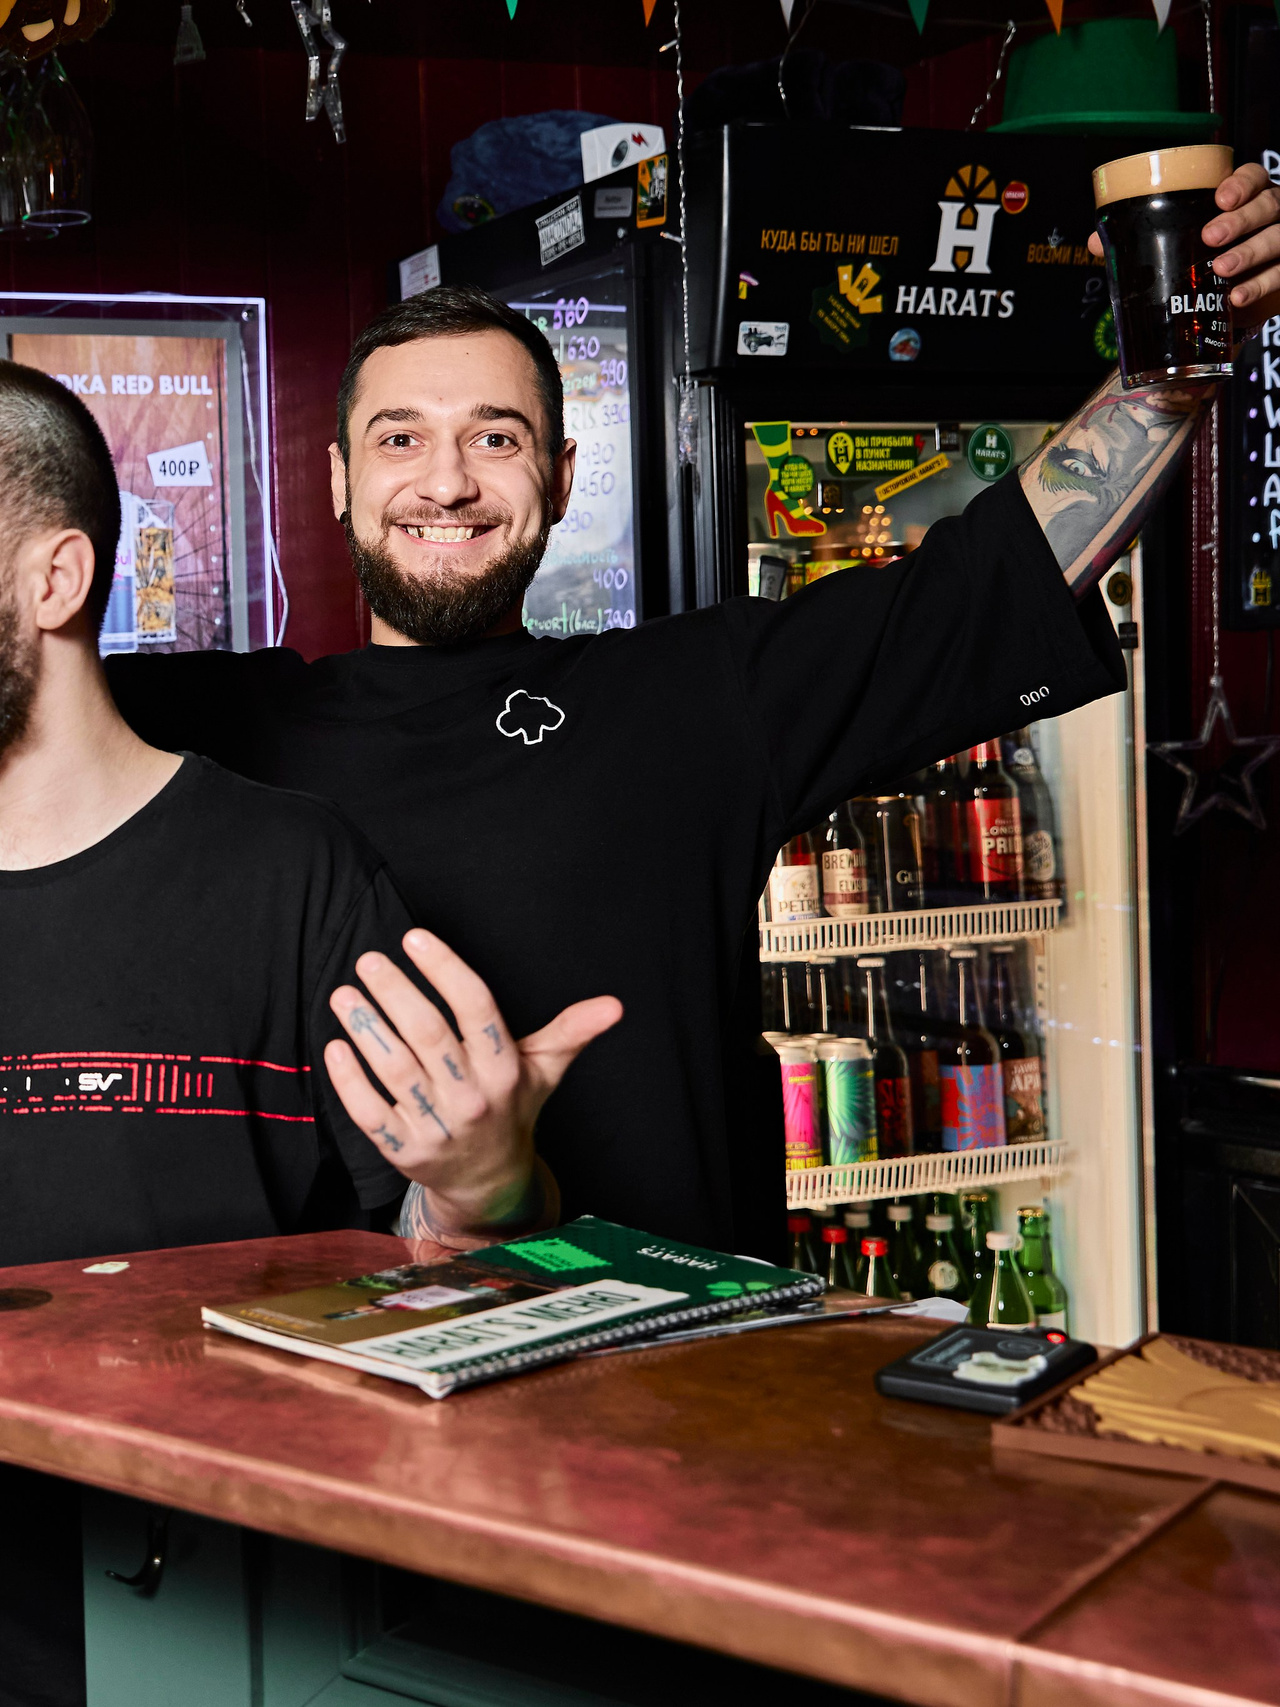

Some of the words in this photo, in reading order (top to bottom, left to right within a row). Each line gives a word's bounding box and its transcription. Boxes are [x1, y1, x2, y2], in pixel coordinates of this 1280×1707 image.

[761, 229, 796, 253] КУДА
[800, 231, 821, 252] БЫ
[825, 232, 845, 253] ТЫ
[847, 233, 866, 254] НИ
[868, 235, 899, 256] ШЕЛ
[1027, 243, 1072, 264] ВОЗМИ
[553, 296, 589, 330] 560
[1170, 293, 1224, 314] BLACK
[568, 335, 600, 361] 630
[600, 358, 628, 387] 390
[112, 375, 153, 395] RED
[159, 375, 213, 396] BULL
[602, 403, 630, 427] 390
[855, 437, 870, 447] ВЫ
[870, 435, 914, 448] ПРИБЫЛИ
[855, 449, 861, 459] В
[862, 448, 891, 459] ПУНКТ
[855, 459, 915, 471] НАЗНАЧЕНИЯ!
[158, 460, 200, 477] 400₽
[578, 471, 616, 497] 450
[593, 568, 629, 591] 400
[603, 608, 636, 631] 390
[78, 1073, 122, 1091] SV
[371, 1316, 536, 1360] HARAT'S
[527, 1289, 641, 1325] МЕНЮ
